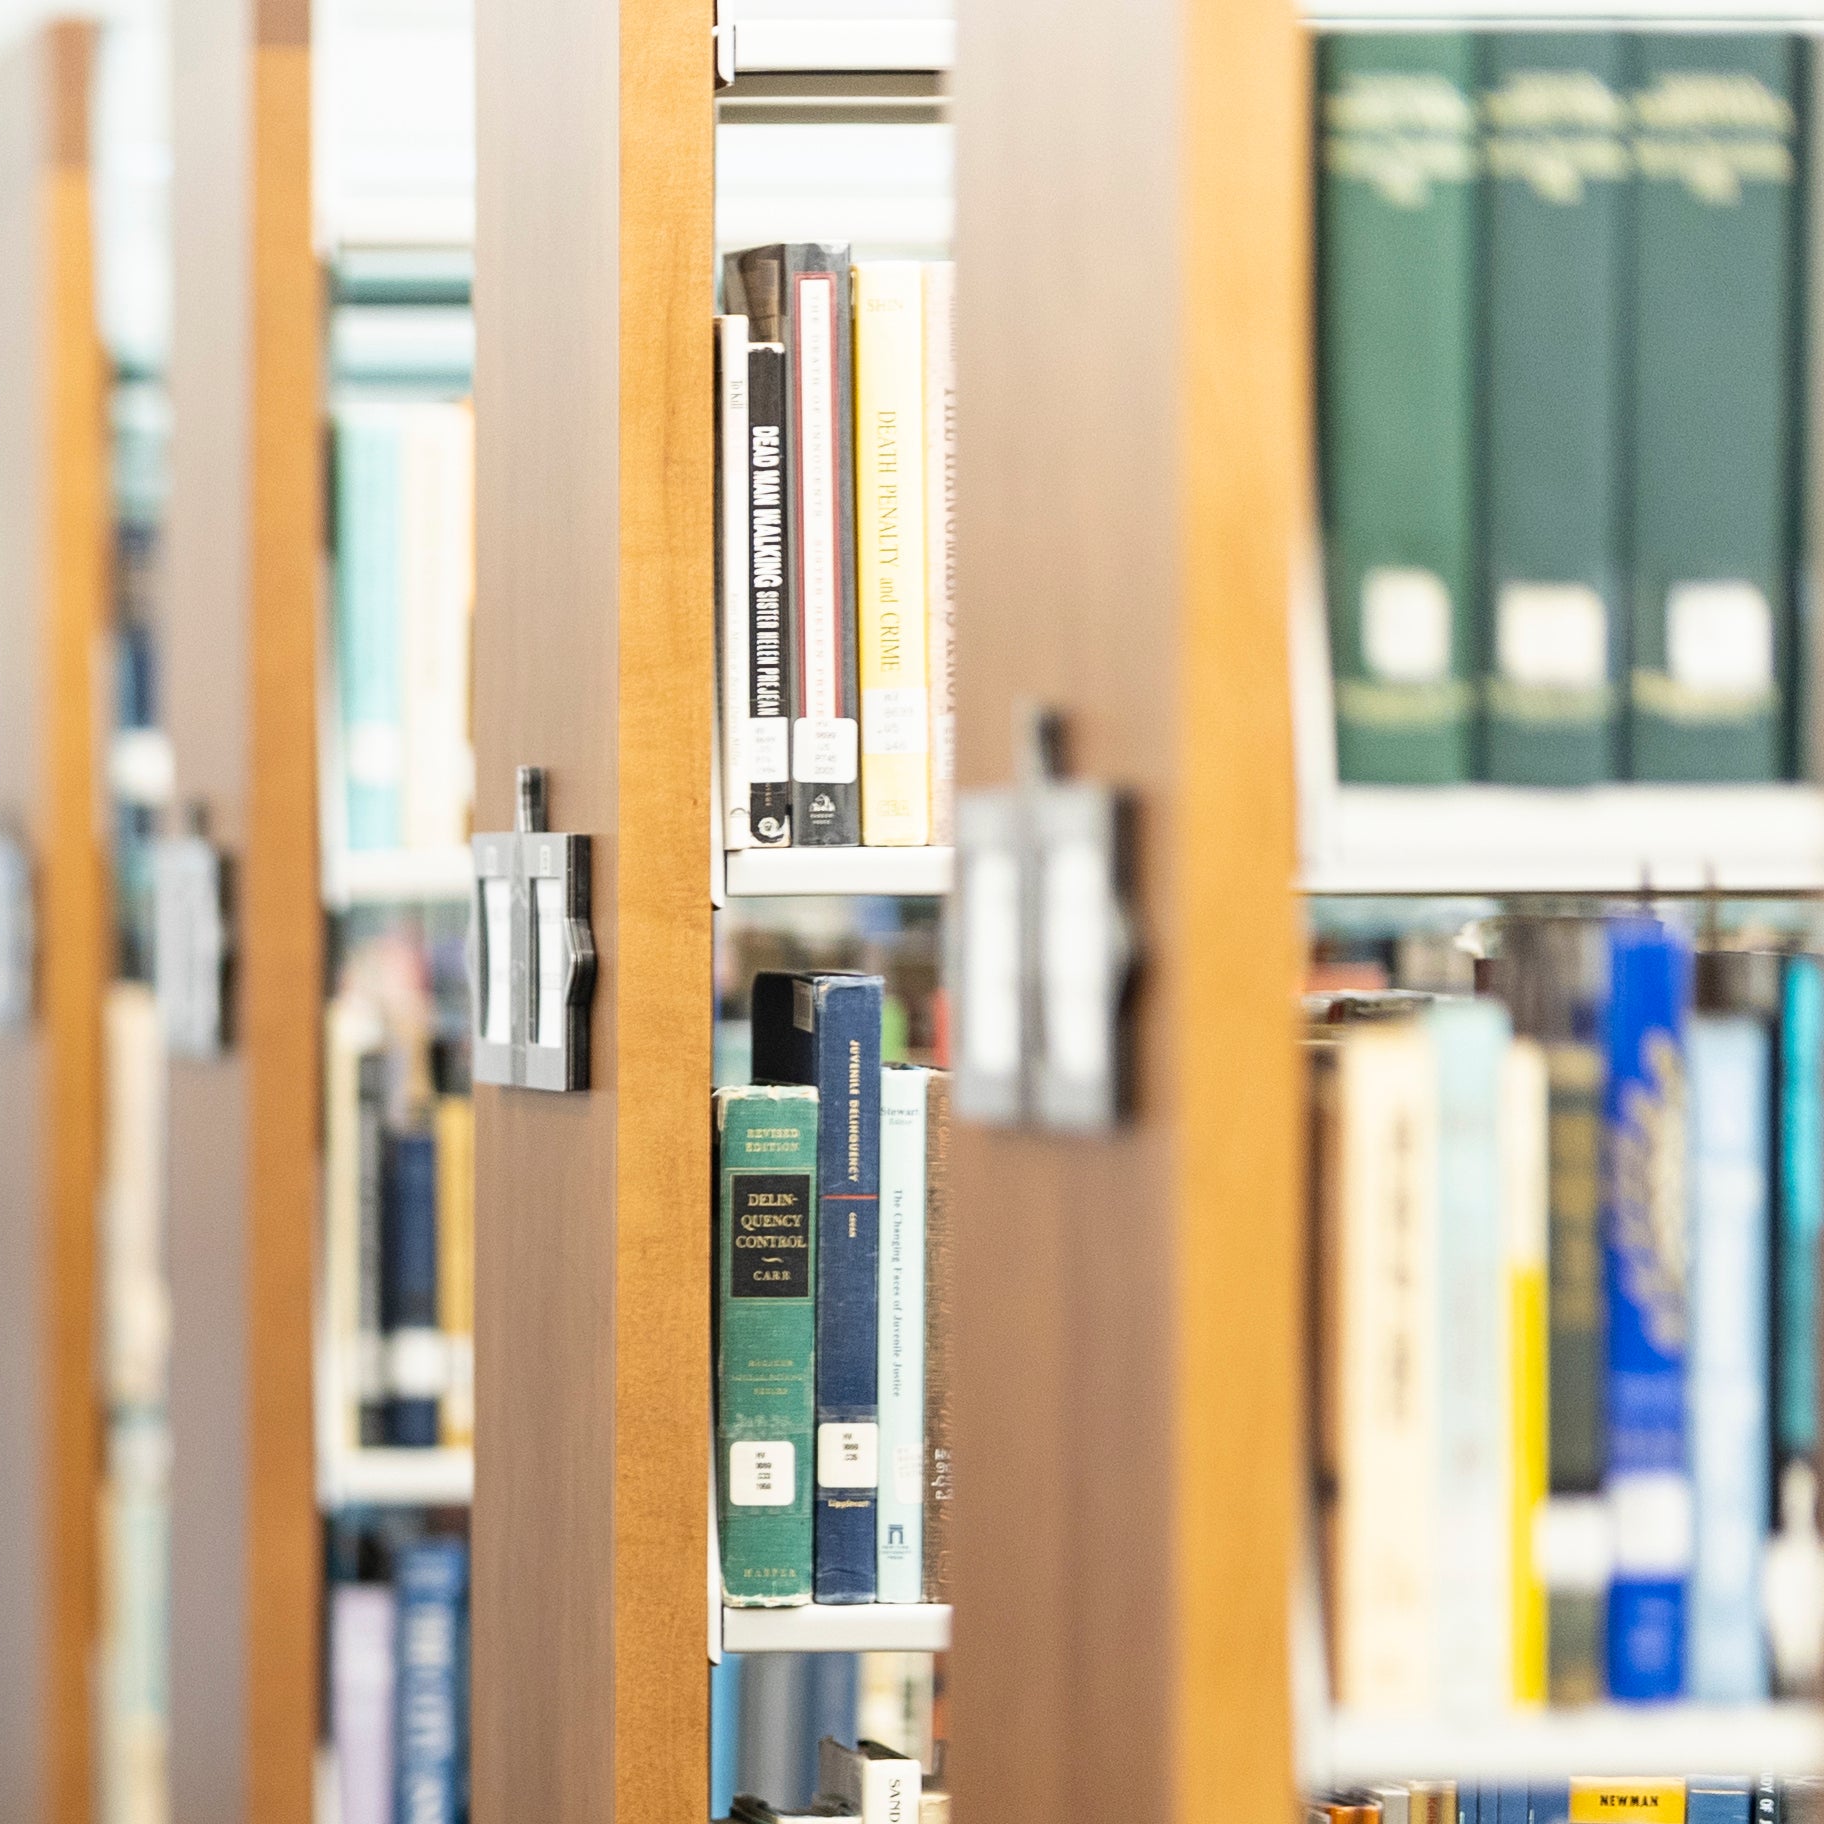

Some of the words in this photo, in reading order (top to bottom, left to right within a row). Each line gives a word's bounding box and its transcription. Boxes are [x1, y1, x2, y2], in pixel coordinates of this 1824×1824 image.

[752, 426, 780, 467] DEAD
[877, 411, 897, 473] DEATH
[753, 470, 780, 505] MAN
[878, 484, 899, 565] PENALTY
[753, 509, 782, 588] WALKING
[880, 579, 899, 603] and
[757, 590, 779, 629] SISTER
[757, 631, 779, 665] HELEN
[880, 613, 900, 672] CRIME
[757, 667, 780, 716] PREJEAN
[849, 1040, 860, 1095] JUVENILE
[849, 1099, 860, 1183] DELINQUENCY
[747, 1194, 798, 1207] DELIN-
[894, 1190, 902, 1208] The
[741, 1214, 802, 1231] QUENCY
[892, 1212, 902, 1263] Changing
[736, 1235, 806, 1248] CONTROL
[753, 1270, 791, 1280] CARR
[893, 1267, 902, 1299] Faces
[893, 1315, 902, 1358] Juvenile
[893, 1363, 902, 1397] Justice
[1600, 1795, 1659, 1807] NEWMAN
[1759, 1798, 1774, 1813] OF
